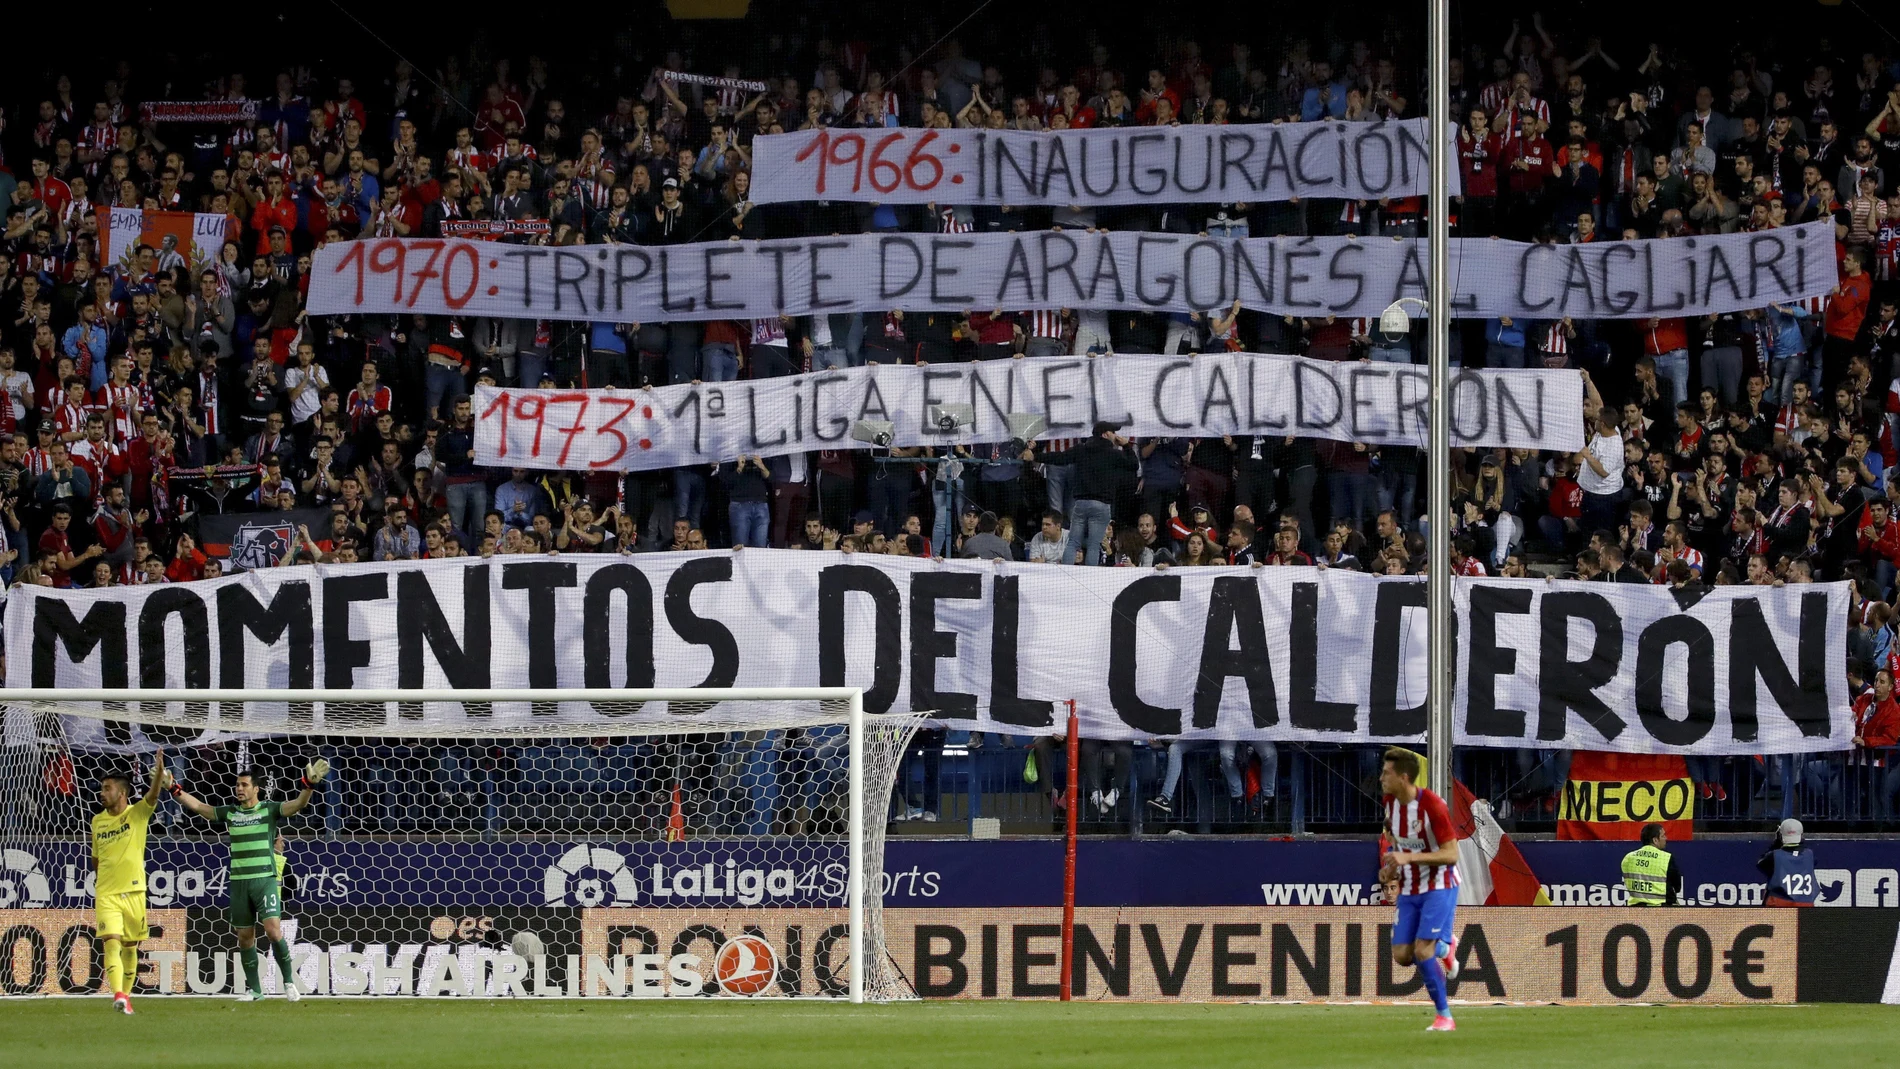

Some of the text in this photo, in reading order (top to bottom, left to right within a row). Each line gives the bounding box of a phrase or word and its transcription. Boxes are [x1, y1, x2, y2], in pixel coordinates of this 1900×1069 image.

[795, 130, 965, 194] 1966:
[99, 212, 155, 231] SIEMPRE
[335, 239, 499, 309] 1970:
[878, 236, 975, 303] DE
[995, 233, 1365, 312] ARAGONÉS
[480, 390, 653, 468] 1973:
[921, 368, 1014, 436] EN
[1042, 359, 1133, 429] EL
[31, 556, 1831, 746] MOMENTOS DEL CALDERÓN
[1565, 778, 1690, 822] MECO
[1635, 859, 1650, 867] 350
[1782, 873, 1813, 896] 123
[262, 893, 277, 908] 13
[148, 951, 413, 995] TURKISH
[428, 953, 703, 997] AIRLINES
[913, 923, 1506, 997] BIENVENIDA
[1544, 922, 1774, 1000] 100€
